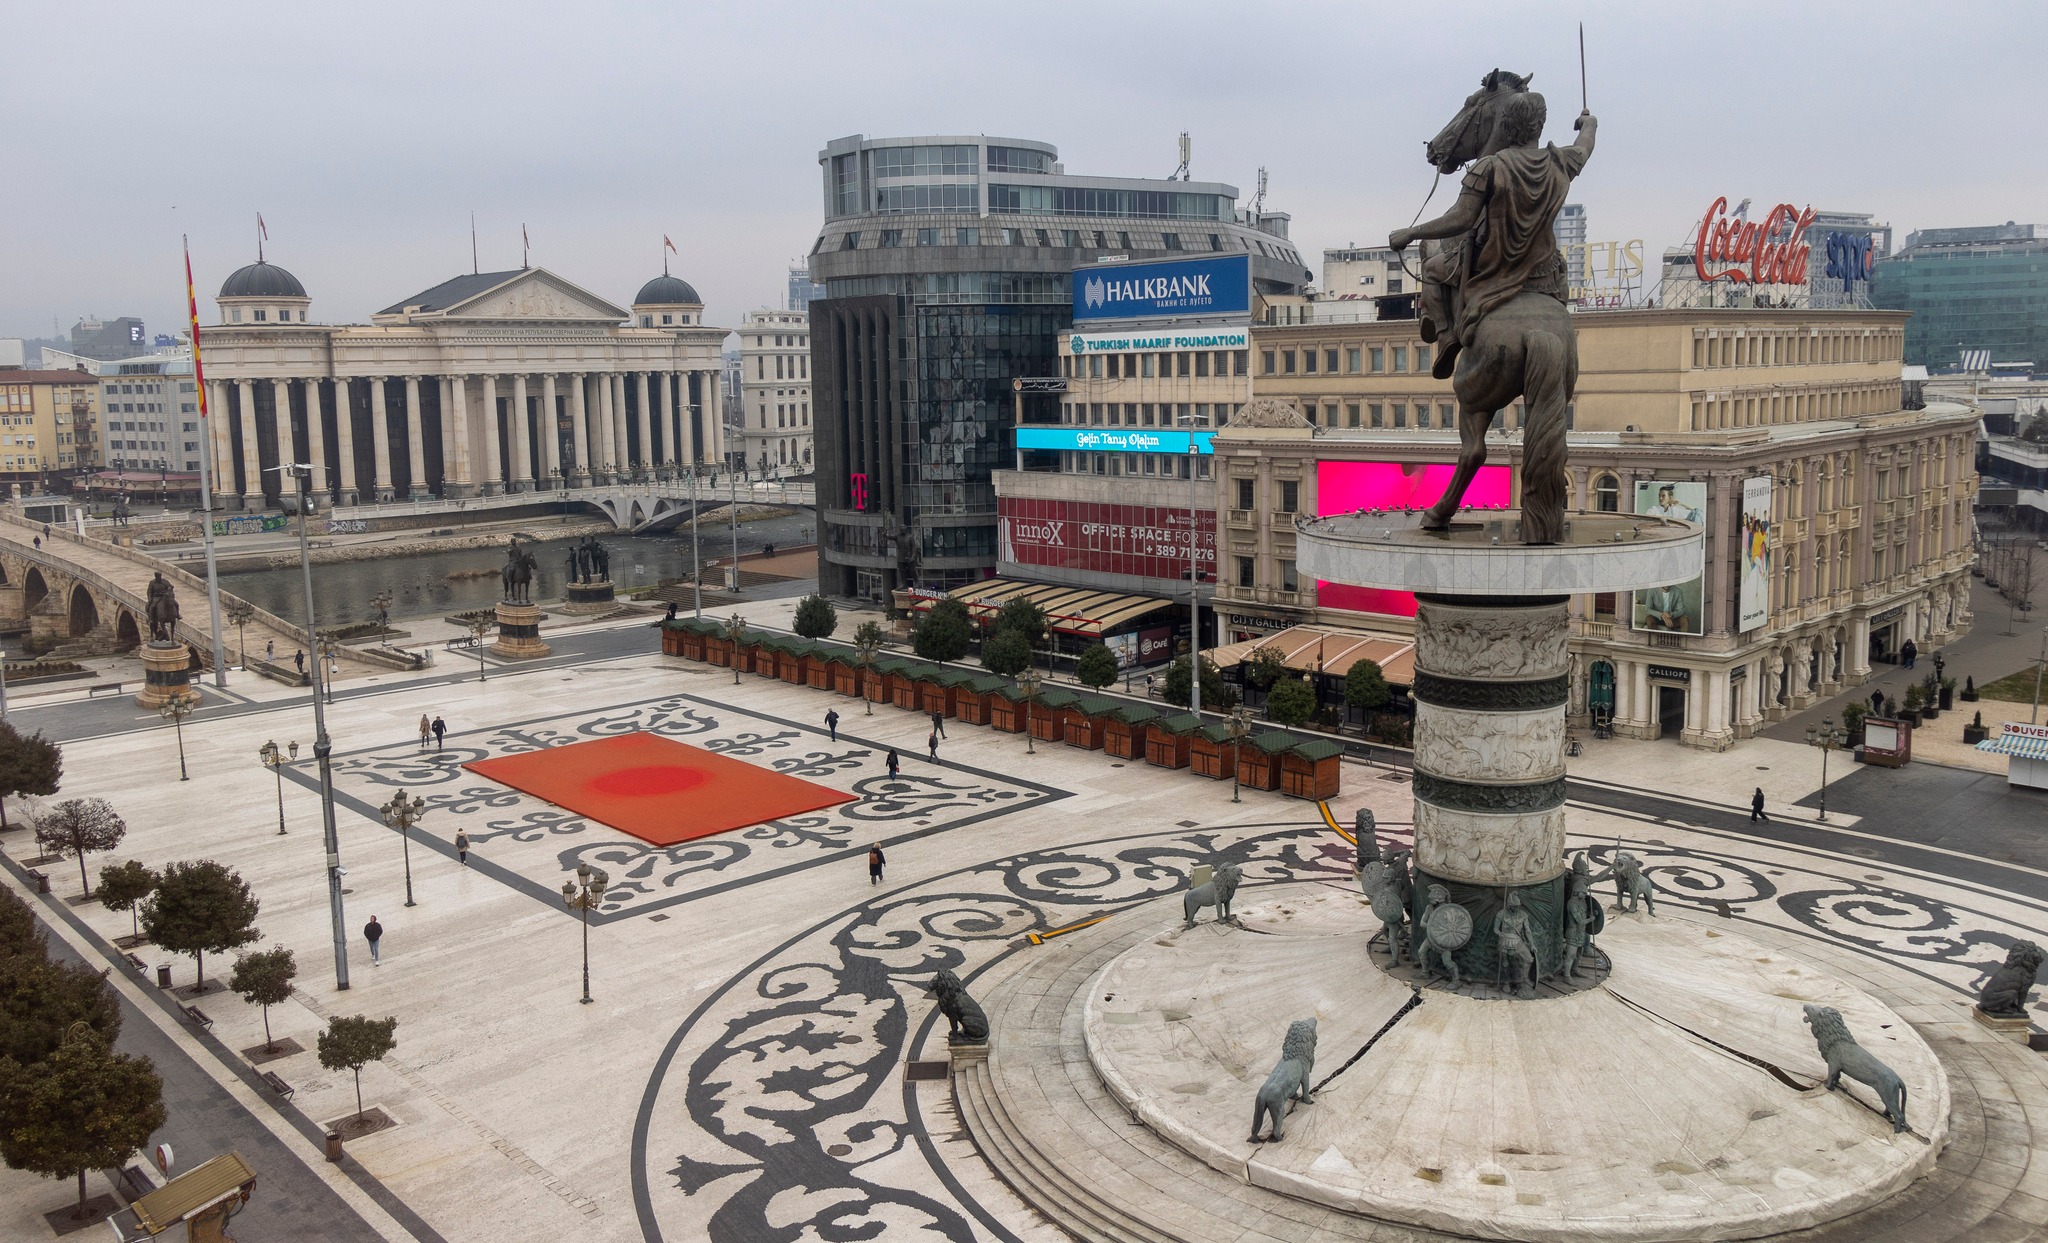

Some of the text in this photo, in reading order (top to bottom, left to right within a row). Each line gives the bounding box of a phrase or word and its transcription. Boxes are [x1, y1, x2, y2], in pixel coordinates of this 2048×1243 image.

[1696, 196, 1819, 286] Coca-Cola
[1562, 238, 1643, 281] TIS
[1107, 273, 1211, 302] HALKBANK
[1087, 334, 1246, 350] TURKISH MAARIF FOUNDATION
[1076, 433, 1100, 448] Gelin
[1100, 433, 1127, 448] Tanış
[1016, 519, 1064, 546] innoX
[1081, 524, 1126, 538] OFFICE
[1130, 528, 1171, 542] SPACE
[1175, 531, 1199, 544] FOR
[1156, 545, 1176, 557] 389
[1180, 546, 1191, 558] 71
[1195, 548, 1214, 560] 276
[915, 589, 938, 598] BURGER
[1232, 614, 1255, 625] CITY
[1649, 668, 1688, 679] CALLIOPE
